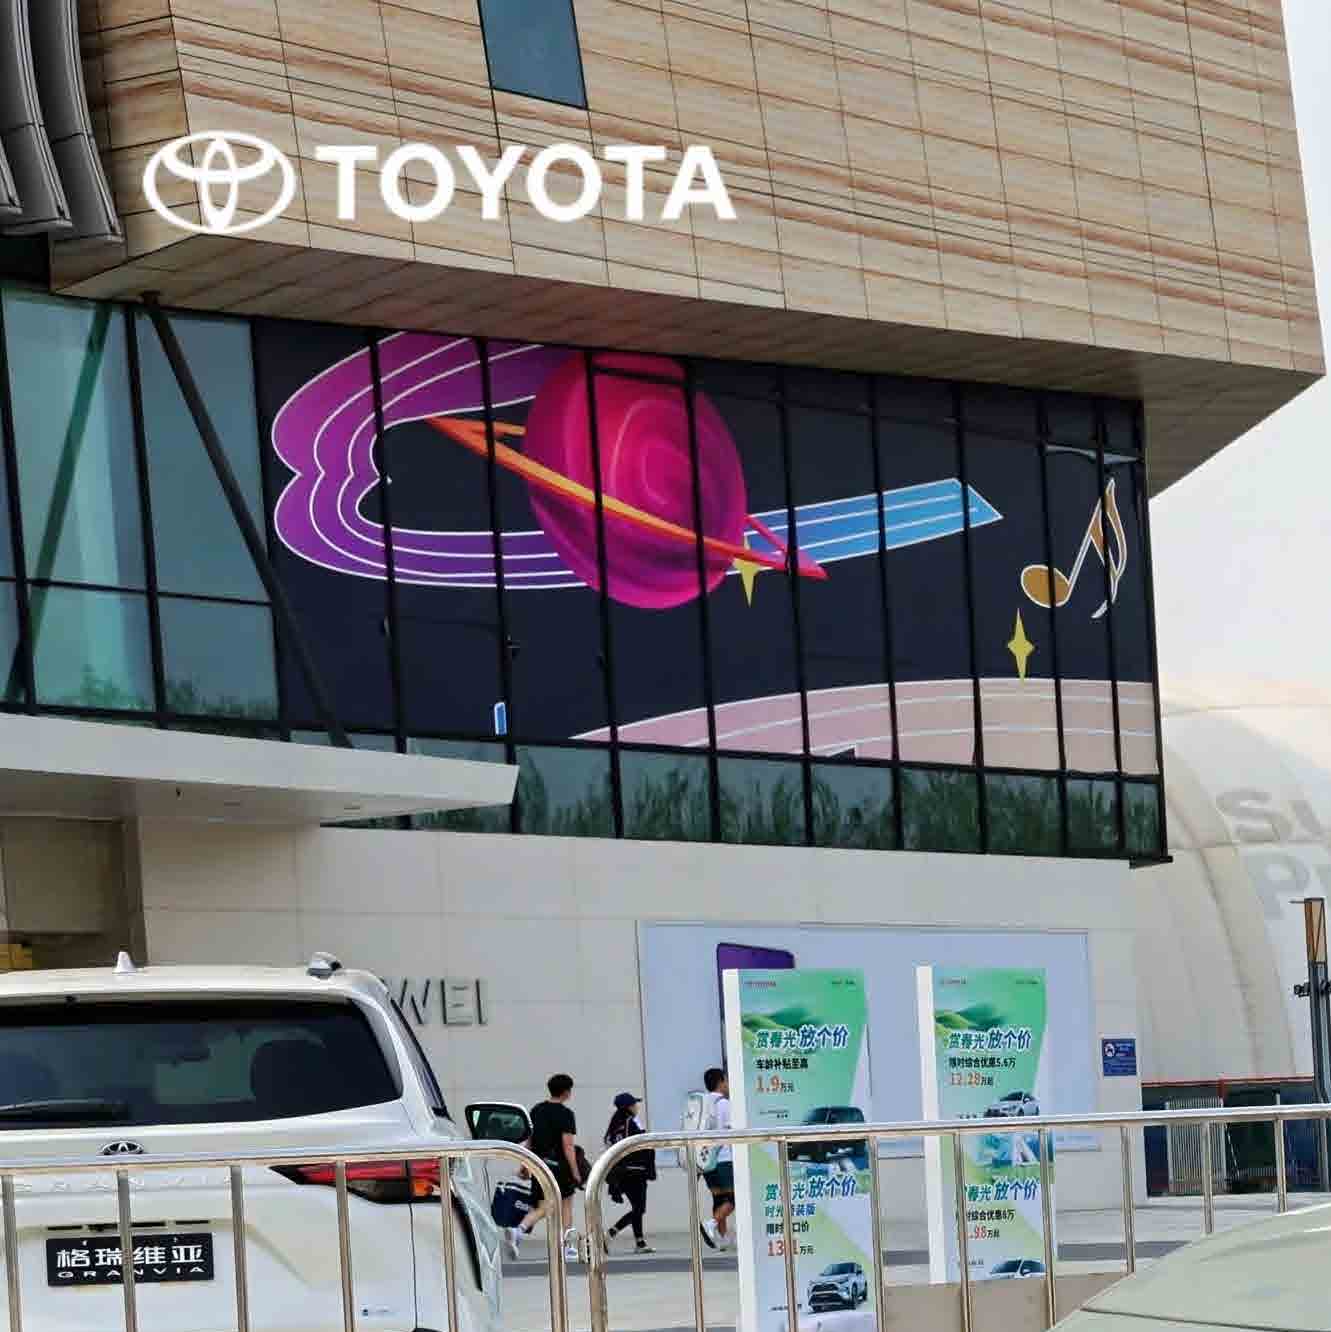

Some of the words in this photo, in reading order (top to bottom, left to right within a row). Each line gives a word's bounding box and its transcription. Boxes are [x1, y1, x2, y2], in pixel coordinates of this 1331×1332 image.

[56, 1245, 205, 1268] 格瑞维亚
[57, 1266, 205, 1279] GRANVIA
